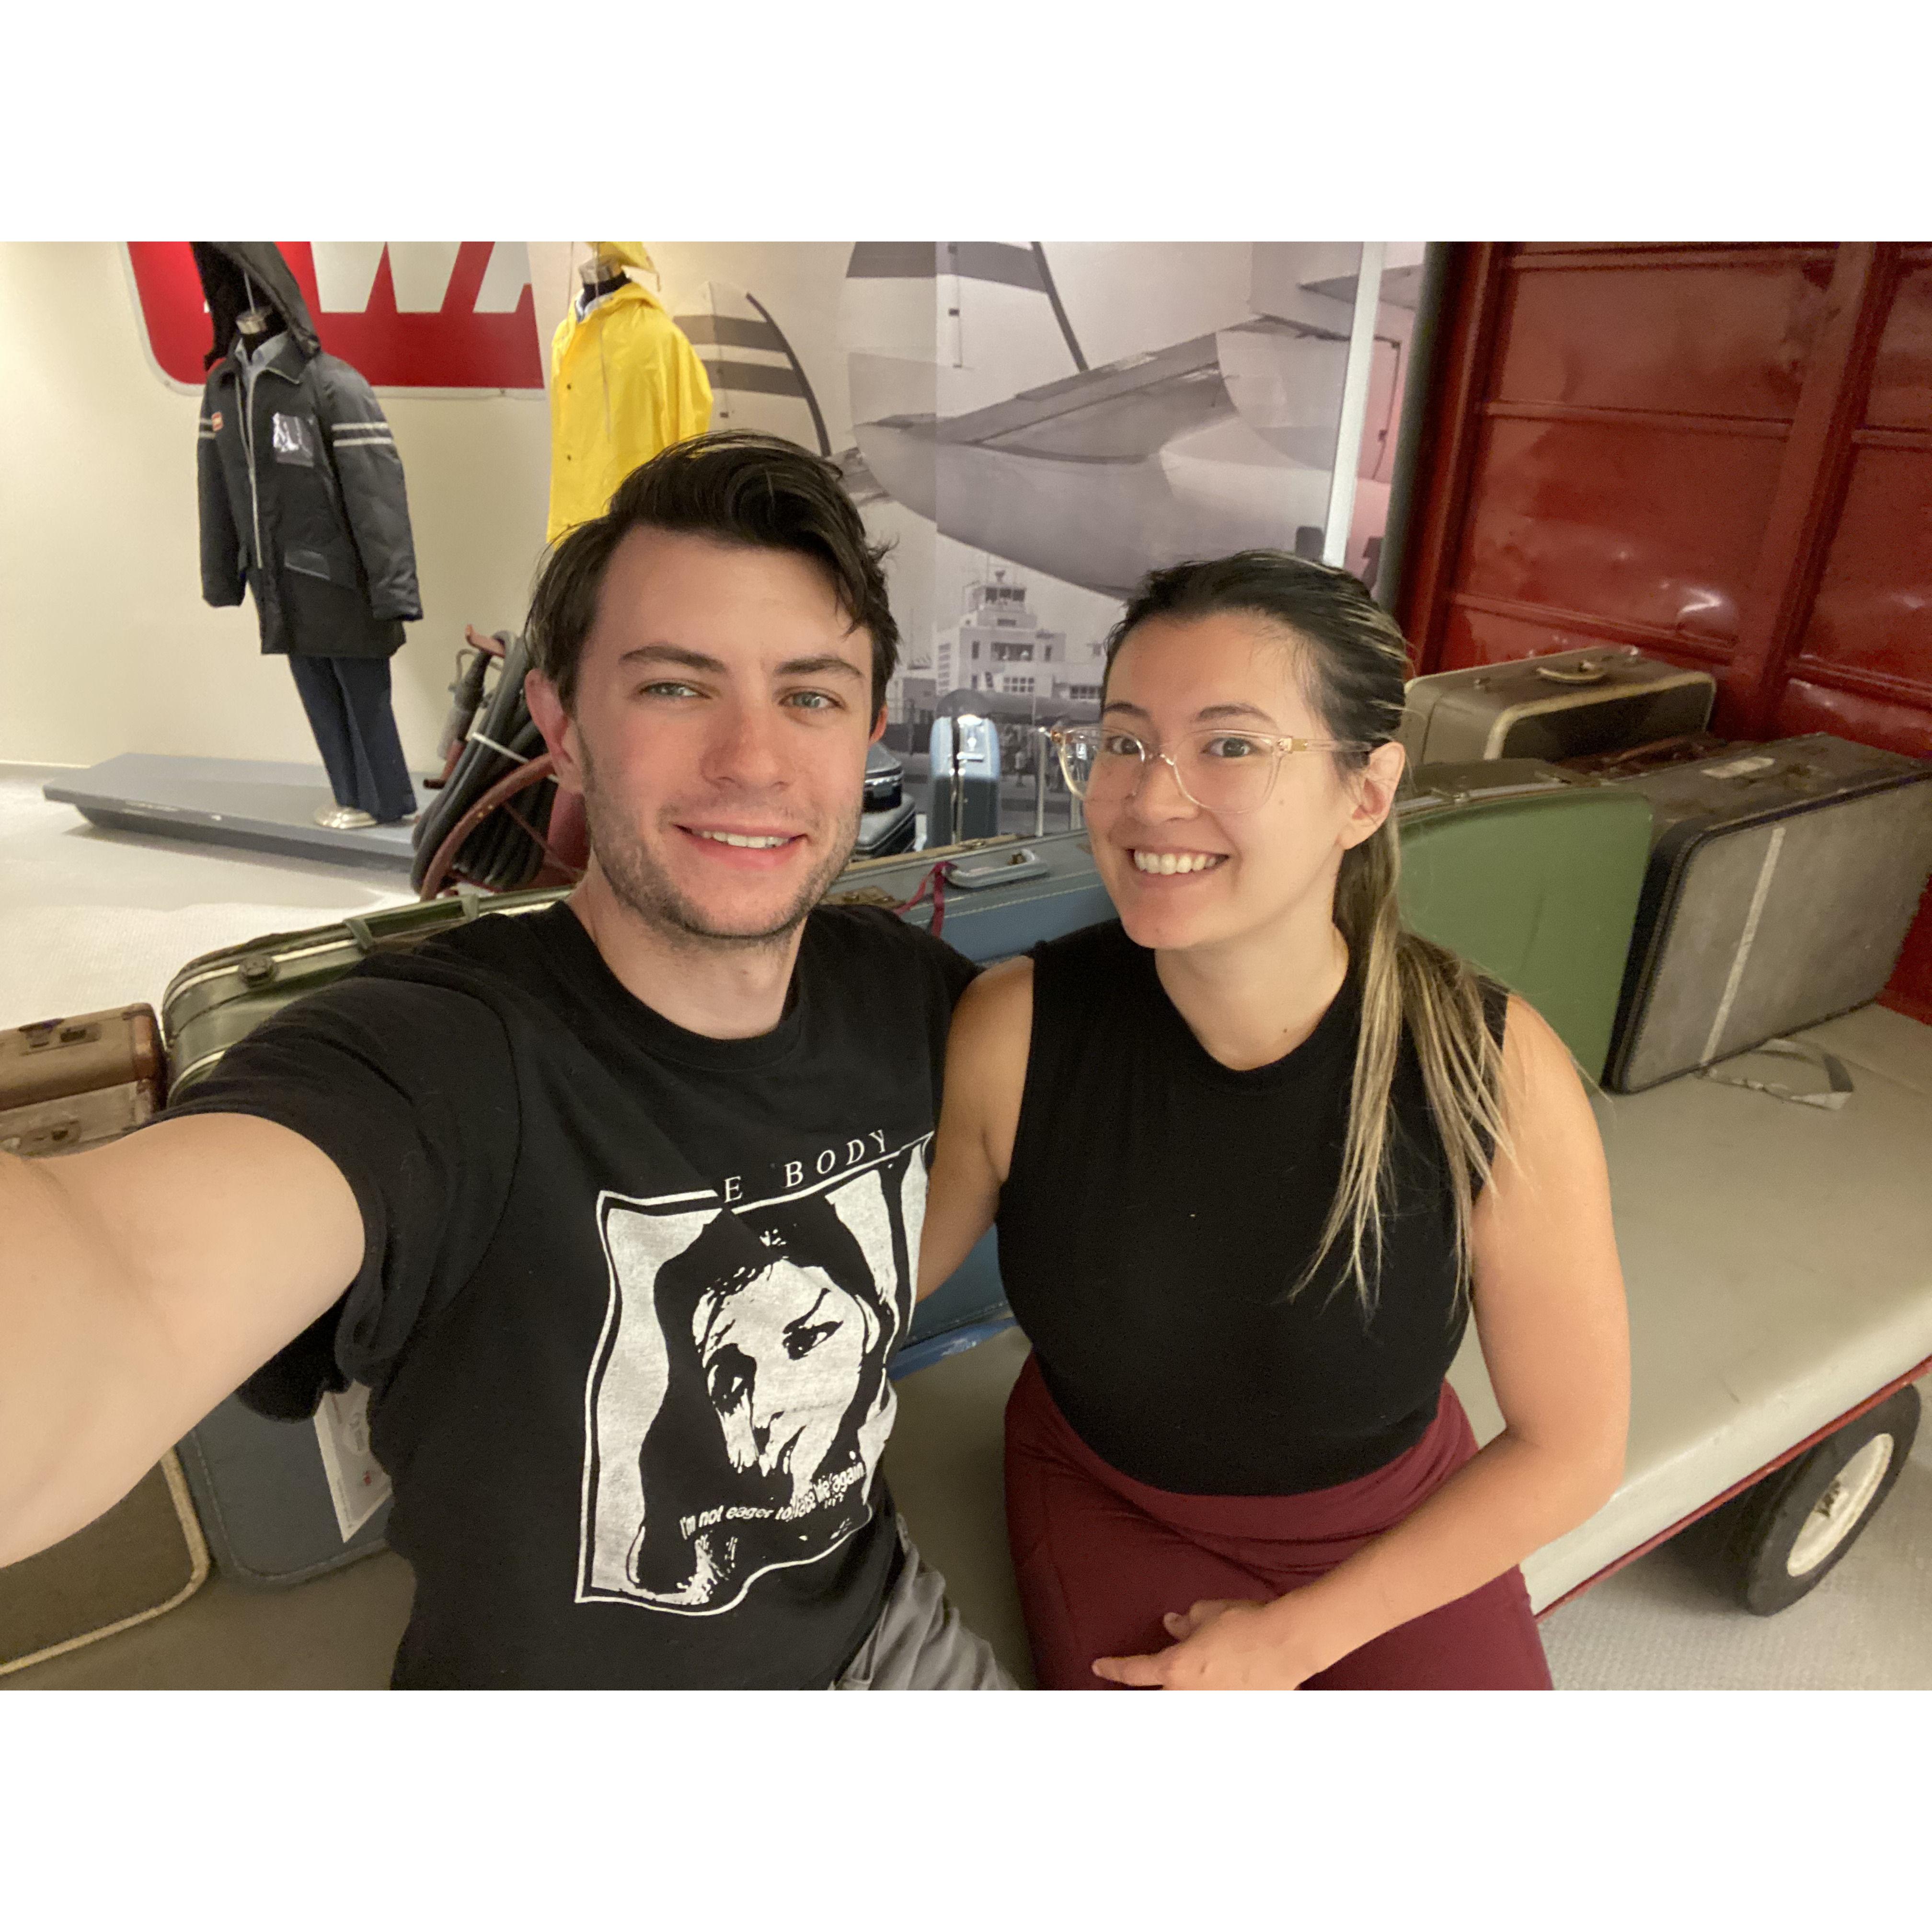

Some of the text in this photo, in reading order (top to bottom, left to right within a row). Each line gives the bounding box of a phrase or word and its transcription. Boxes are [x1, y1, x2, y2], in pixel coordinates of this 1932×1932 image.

[784, 1129, 886, 1188] BODY
[698, 1505, 725, 1528] not
[725, 1506, 774, 1520] eager
